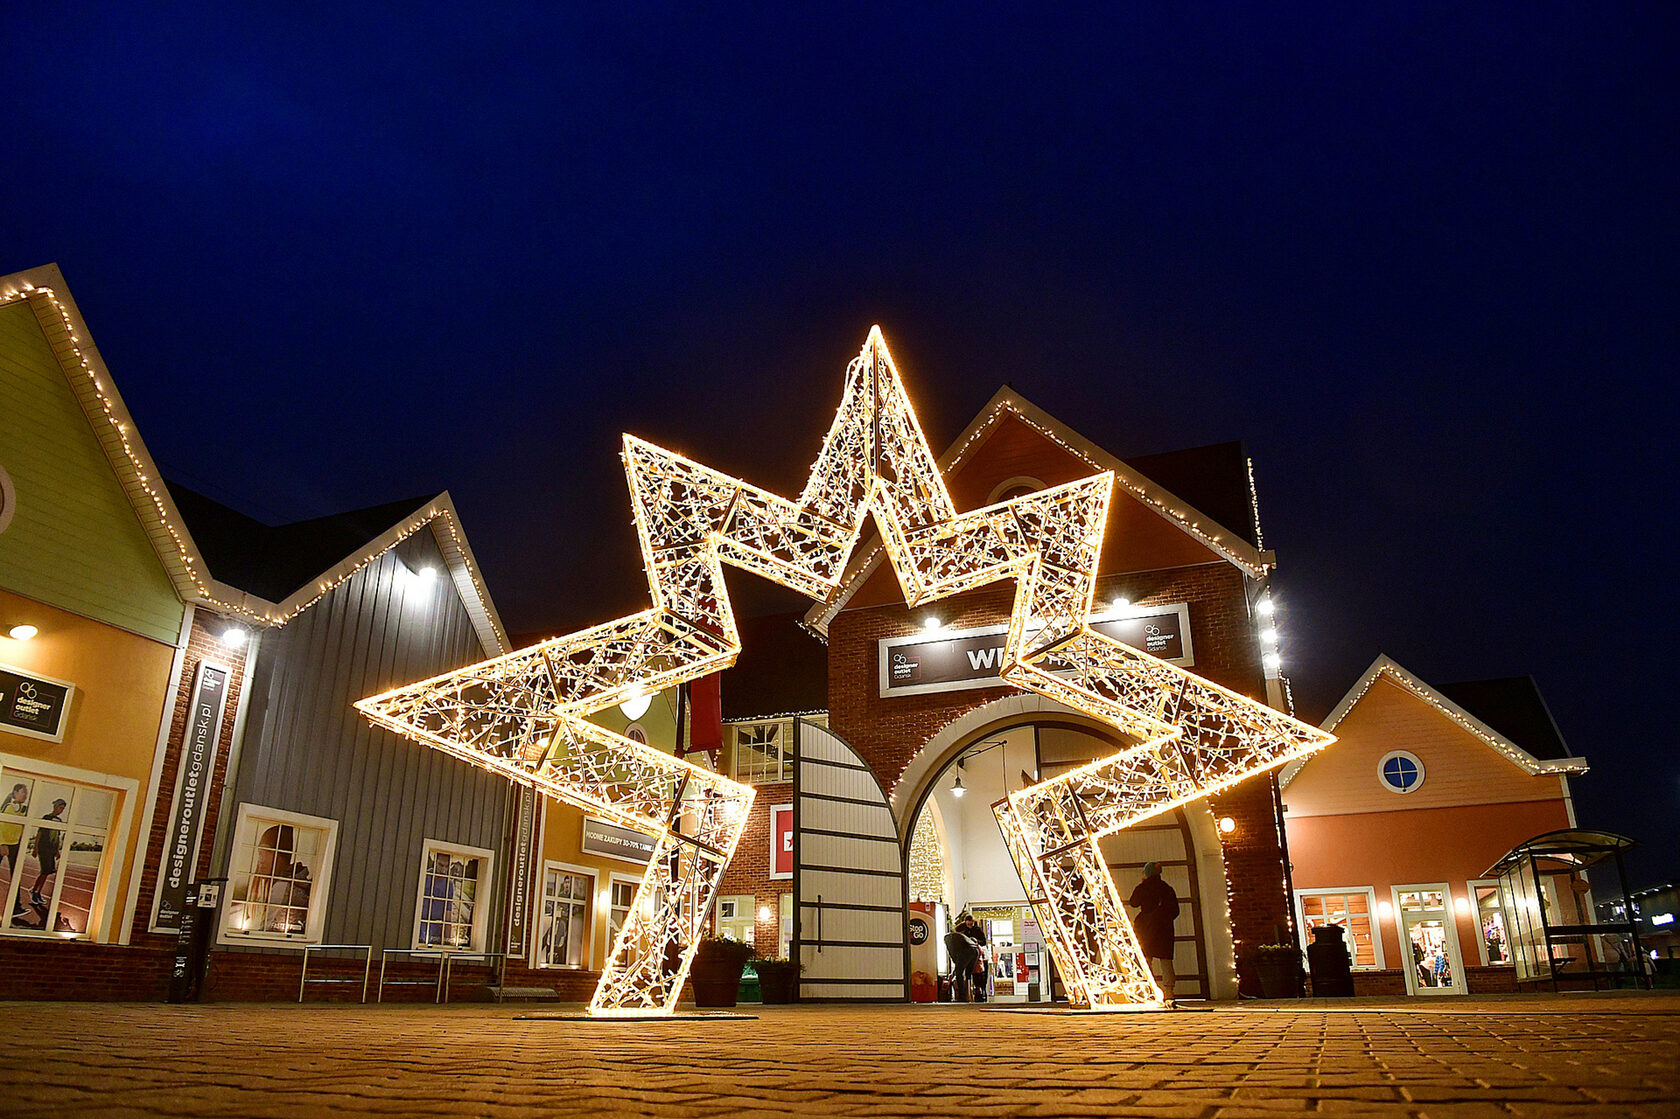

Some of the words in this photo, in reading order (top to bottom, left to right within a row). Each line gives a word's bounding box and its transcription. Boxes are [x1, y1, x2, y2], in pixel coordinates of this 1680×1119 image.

[894, 662, 919, 670] designer
[15, 704, 40, 715] outlet
[17, 697, 51, 710] designer
[169, 703, 212, 888] designeroutletgdansk.pl
[514, 792, 531, 927] designeroutletgdansk.pl
